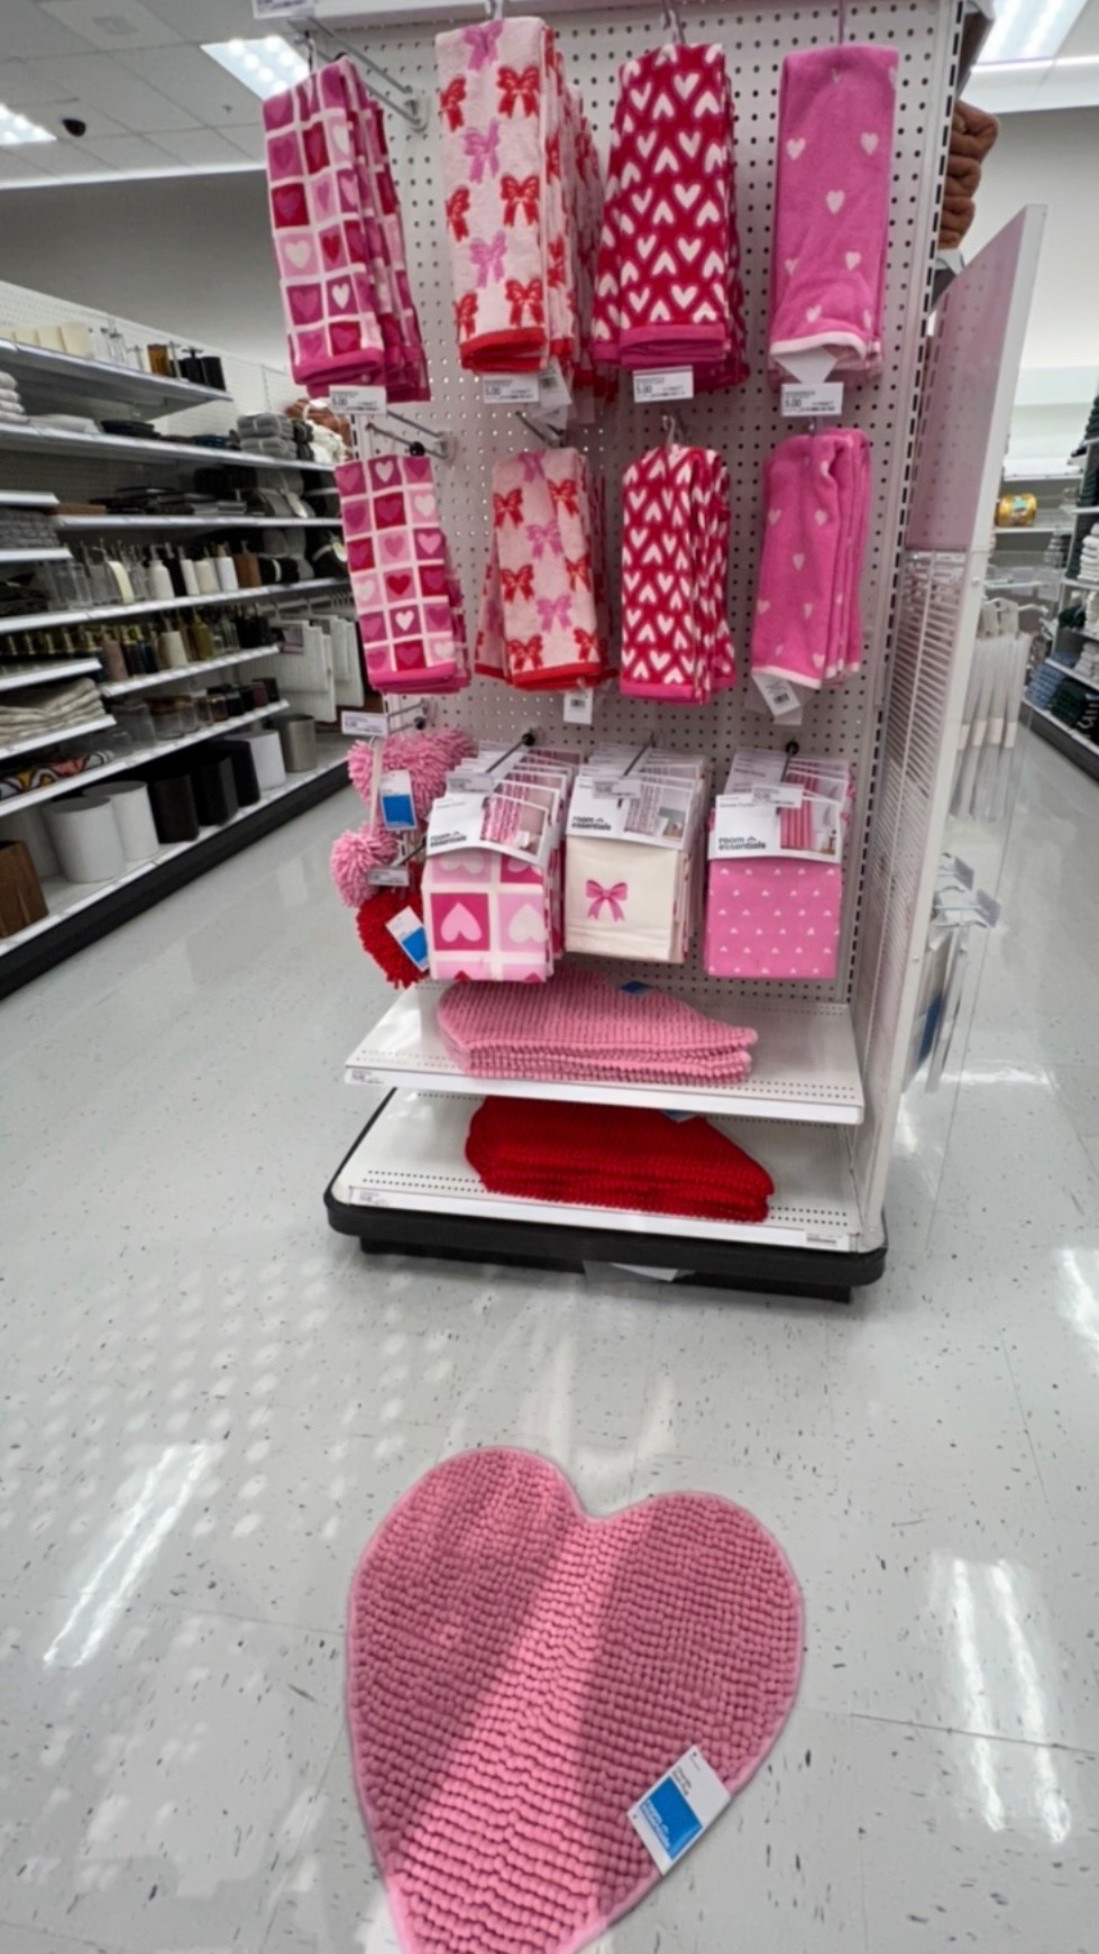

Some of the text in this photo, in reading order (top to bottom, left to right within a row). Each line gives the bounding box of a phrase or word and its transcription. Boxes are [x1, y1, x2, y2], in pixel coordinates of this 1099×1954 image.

[785, 399, 802, 407] 5.00
[571, 822, 612, 831] essentials
[430, 835, 467, 847] essentials
[718, 841, 766, 850] essentials
